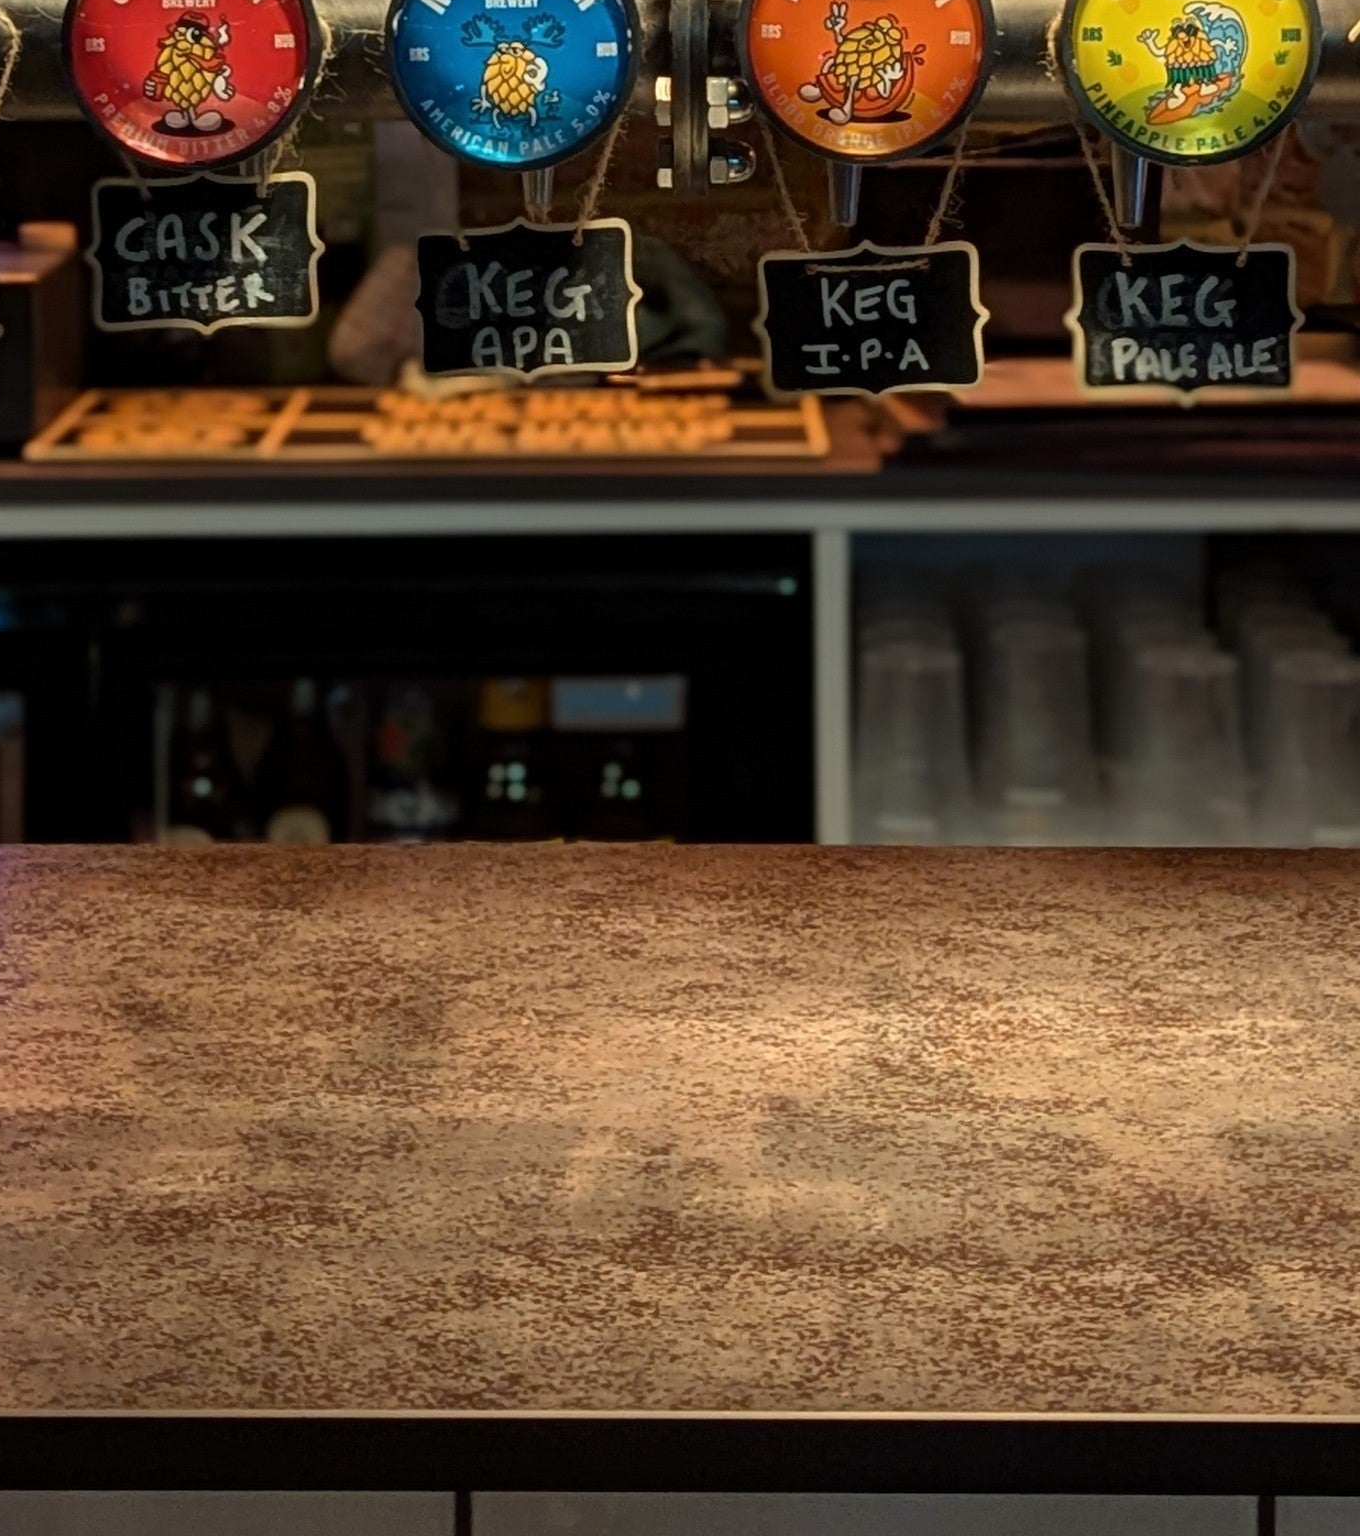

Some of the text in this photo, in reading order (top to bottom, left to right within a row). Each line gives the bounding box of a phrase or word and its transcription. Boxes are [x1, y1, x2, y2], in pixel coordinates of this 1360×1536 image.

[178, 128, 250, 155] BITTER
[419, 98, 509, 156] AMERICAN
[519, 129, 568, 155] PALE
[1085, 81, 1295, 152] PINEAPPLE PALE 4.0%
[115, 211, 268, 263] CASK
[128, 272, 276, 316] BITTER
[463, 261, 592, 323] KEG
[820, 276, 918, 328] KEG
[1115, 270, 1237, 328] KEG
[471, 326, 574, 369] APA
[1111, 336, 1280, 382] PALE ALE
